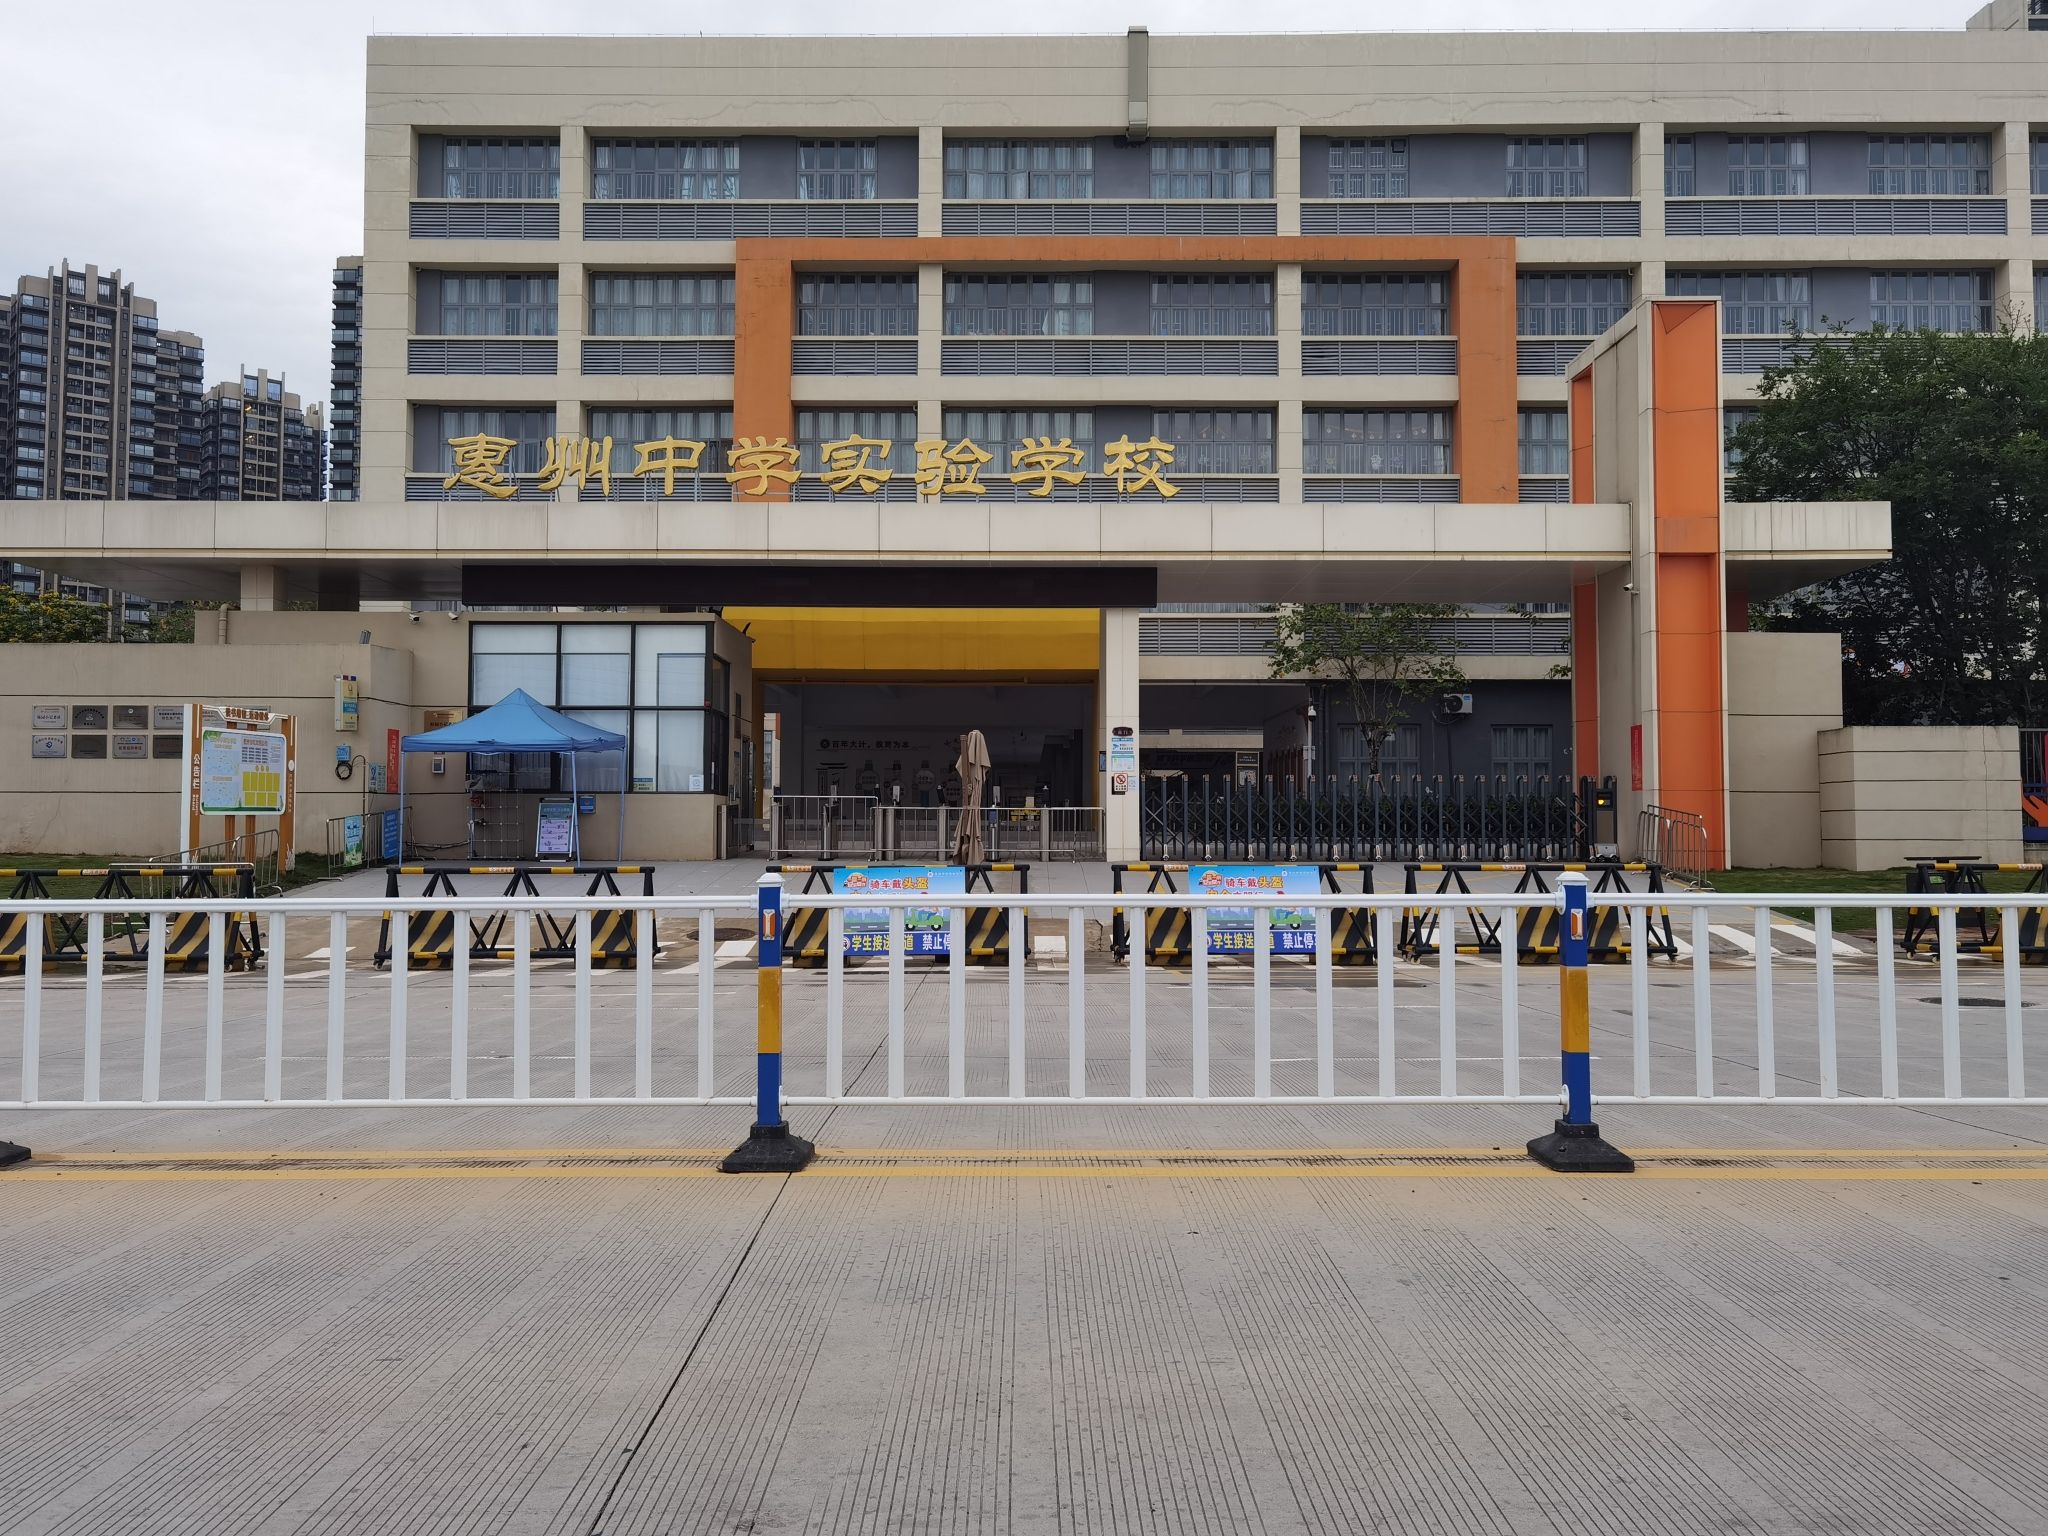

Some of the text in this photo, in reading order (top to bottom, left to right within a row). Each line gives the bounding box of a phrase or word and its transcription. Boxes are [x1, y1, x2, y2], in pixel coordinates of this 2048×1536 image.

[443, 433, 1181, 498] 惠州中学实验学校
[871, 877, 928, 889] 骑车戴头盔
[1226, 876, 1284, 888] 骑车戴头盔
[852, 934, 913, 951] 学生接送道
[922, 934, 951, 951] 禁止停
[1213, 932, 1275, 949] 学生接送
[1283, 932, 1316, 949] 禁止停
